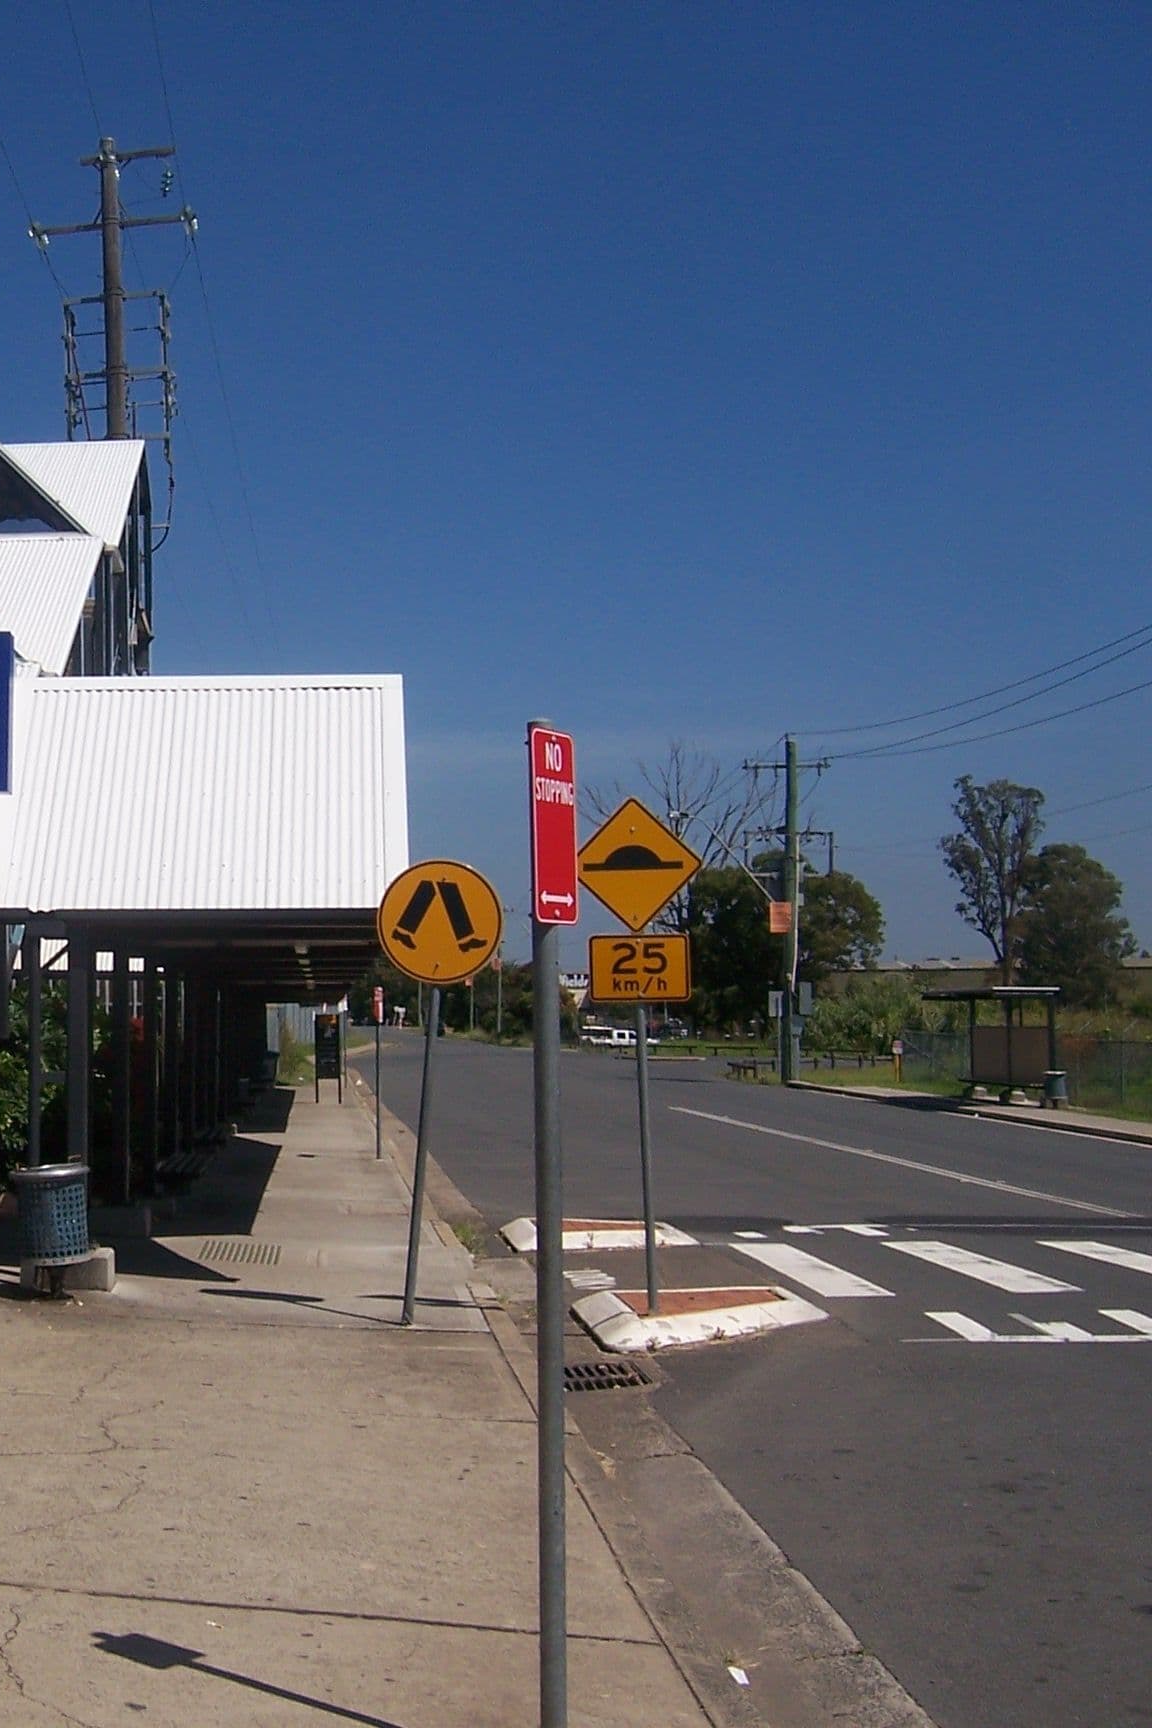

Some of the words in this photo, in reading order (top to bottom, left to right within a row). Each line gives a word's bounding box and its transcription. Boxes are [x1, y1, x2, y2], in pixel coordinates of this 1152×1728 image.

[545, 741, 562, 772] NO
[536, 776, 574, 806] STOPPING
[611, 942, 667, 975] 25
[612, 976, 667, 994] km/h
